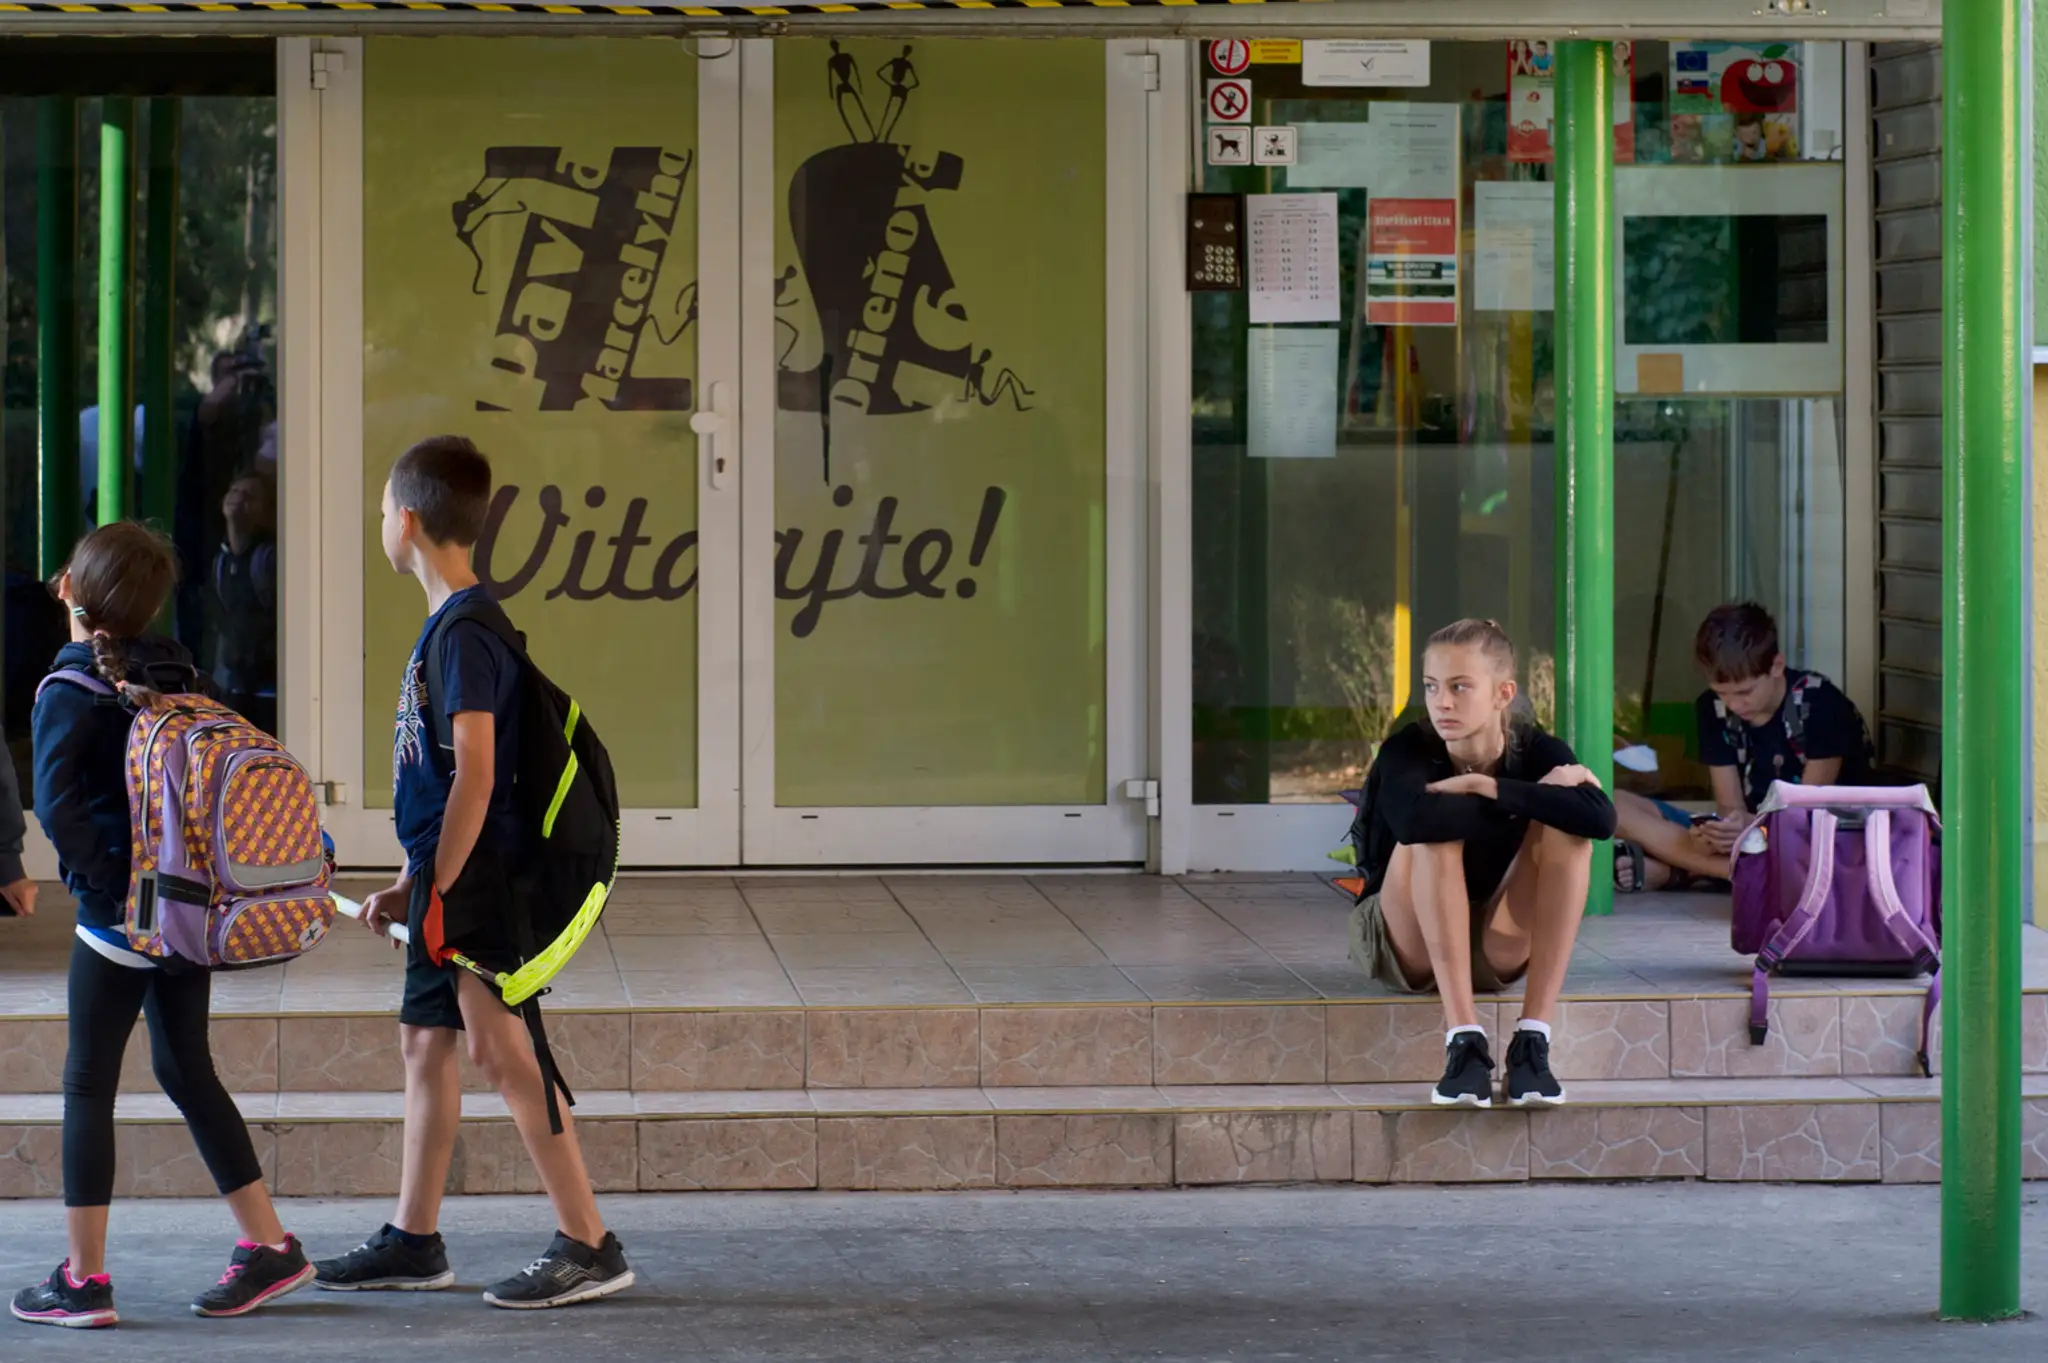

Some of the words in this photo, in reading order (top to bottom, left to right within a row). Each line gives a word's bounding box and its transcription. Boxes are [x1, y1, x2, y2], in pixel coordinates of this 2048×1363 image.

[477, 146, 612, 412] Pavla
[575, 146, 690, 415] Marcelyho
[832, 146, 938, 414] Drieňová
[893, 284, 975, 410] 16
[473, 484, 1008, 639] Vitajte!
